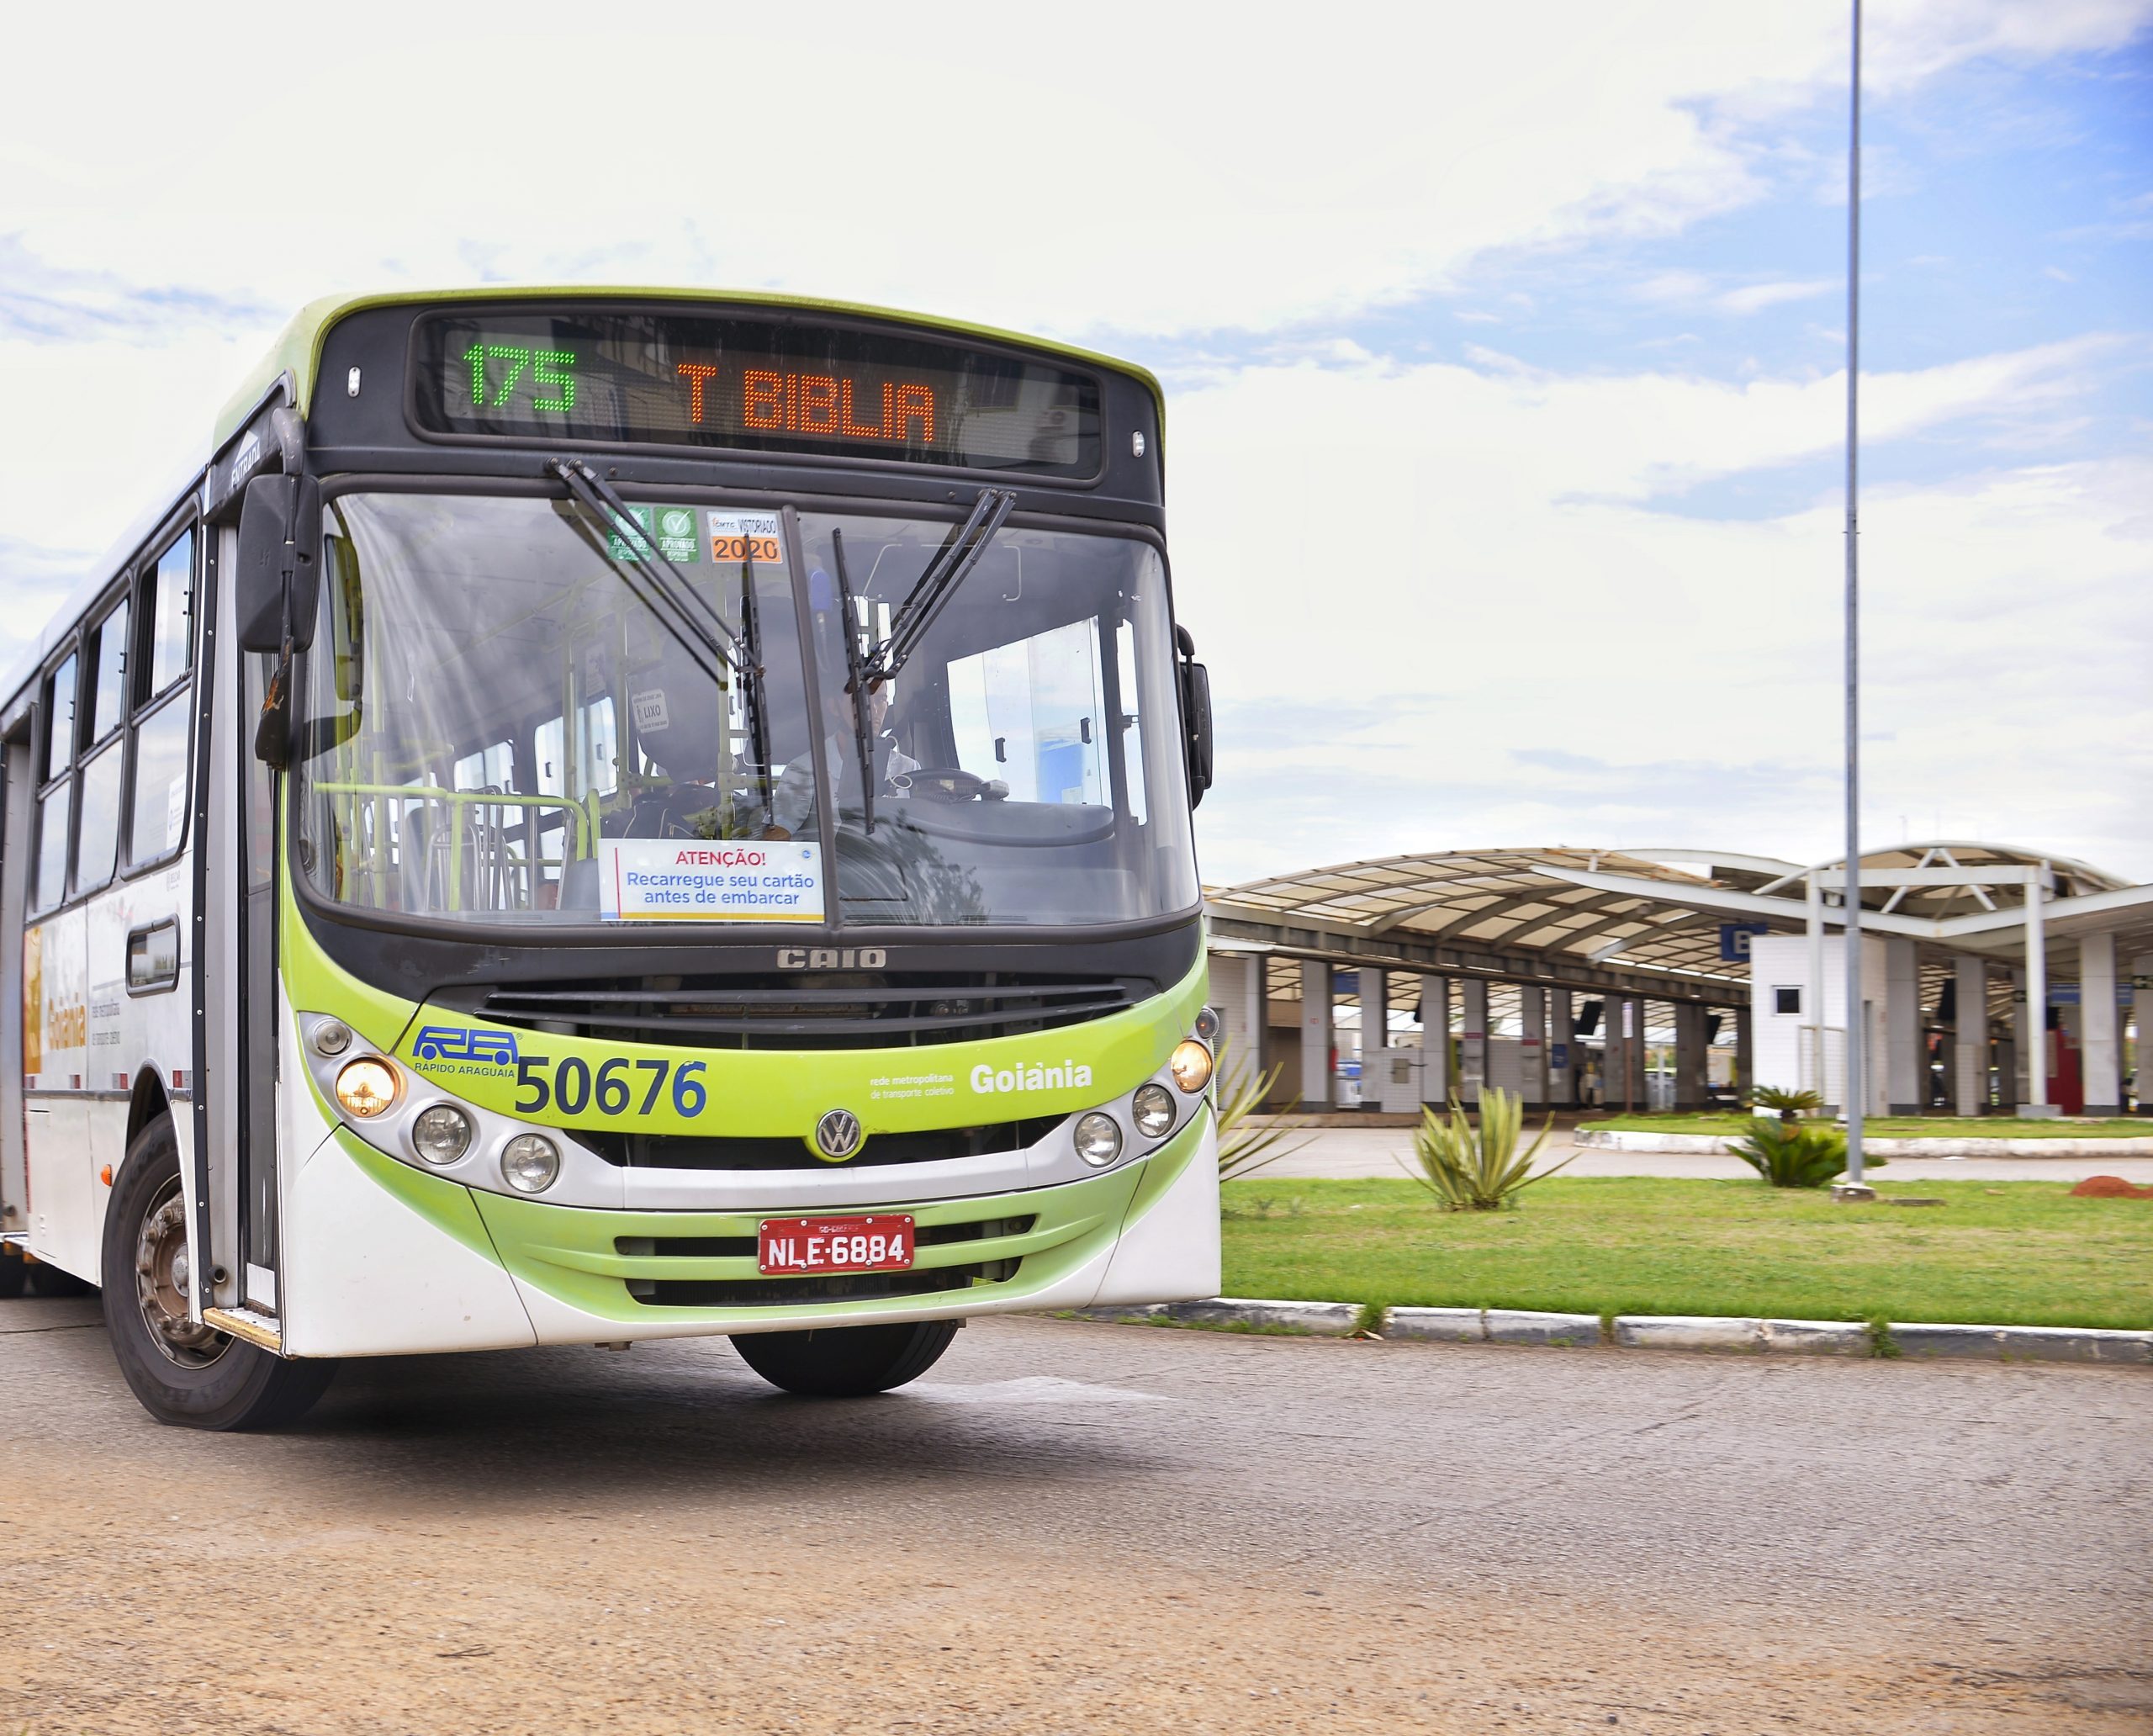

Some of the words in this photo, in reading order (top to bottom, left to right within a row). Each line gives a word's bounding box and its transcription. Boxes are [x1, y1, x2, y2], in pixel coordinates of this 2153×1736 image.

[463, 344, 576, 413] 175
[677, 363, 717, 424] T
[743, 369, 935, 442] BIBLIA
[714, 539, 778, 559] 2020
[643, 704, 661, 718] LIXO
[675, 848, 768, 868] ATENÇÃO!
[627, 871, 725, 889] Recarregue
[729, 876, 759, 887] seu
[762, 873, 815, 888] cartão
[644, 891, 690, 904] antes
[695, 890, 717, 904] de
[721, 890, 800, 905] embarcar
[776, 949, 887, 968] CAIO
[415, 1061, 456, 1073] RÁPIDO
[458, 1066, 515, 1078] ARAGUAIA
[515, 1056, 707, 1119] 50676
[870, 1077, 890, 1086] rede
[892, 1073, 954, 1086] metropolitana
[870, 1090, 881, 1099] de
[882, 1089, 923, 1100] transporte
[925, 1087, 955, 1096] coletivo
